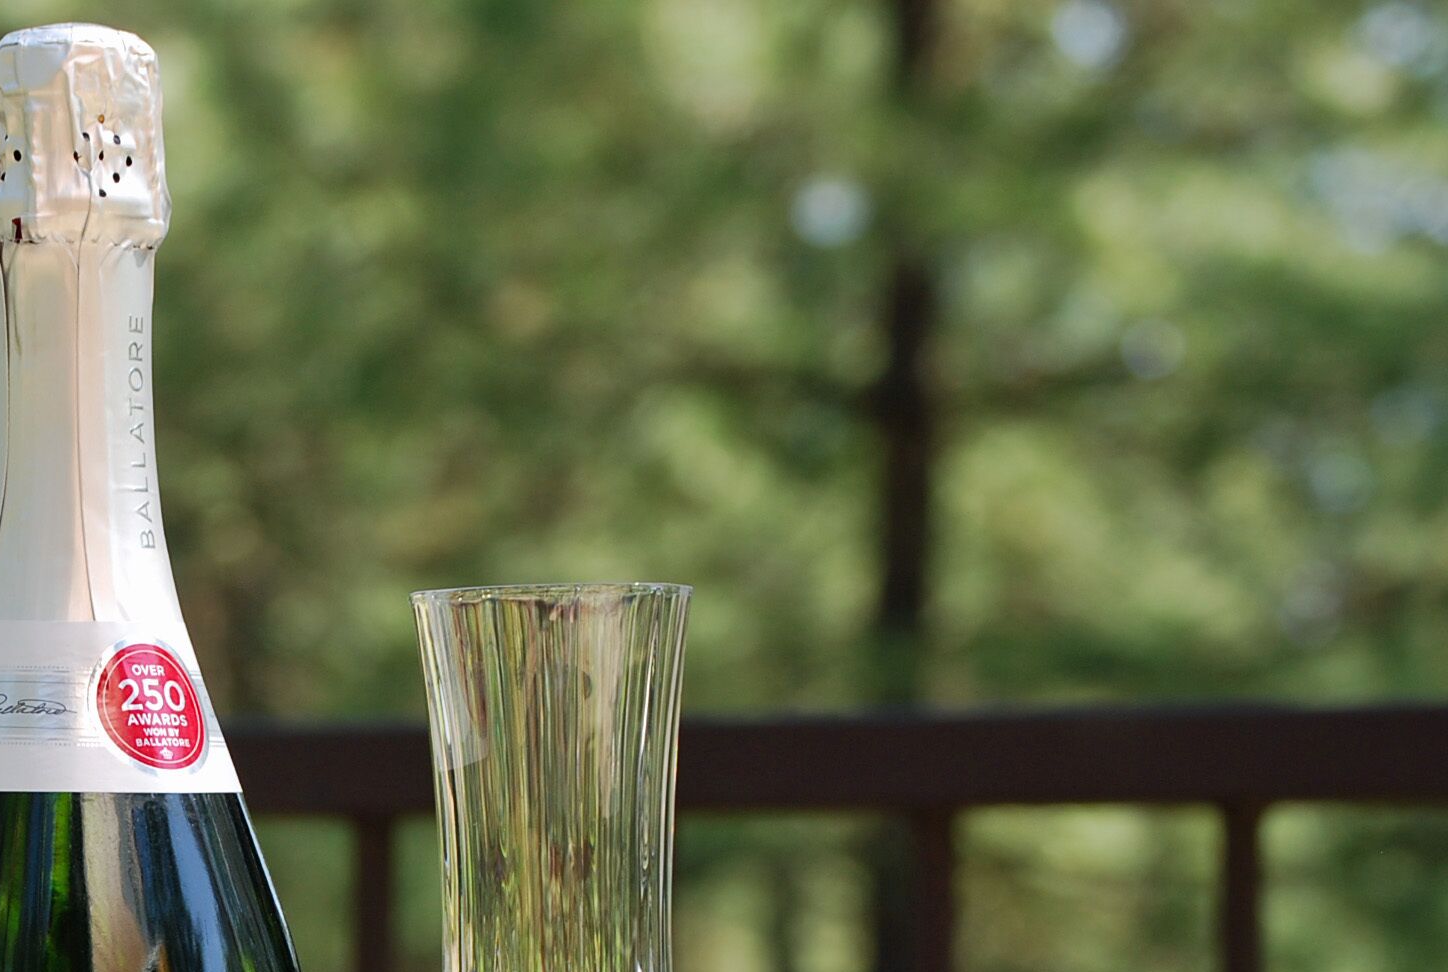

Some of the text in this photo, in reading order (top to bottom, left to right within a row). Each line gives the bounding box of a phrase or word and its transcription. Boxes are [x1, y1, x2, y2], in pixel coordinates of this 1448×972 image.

[128, 314, 156, 549] BALLATORE
[131, 664, 165, 677] OVER
[118, 678, 186, 712] 250
[127, 713, 188, 727] AWARDS
[143, 727, 180, 737] WON BY
[135, 738, 191, 747] BALLATORE
